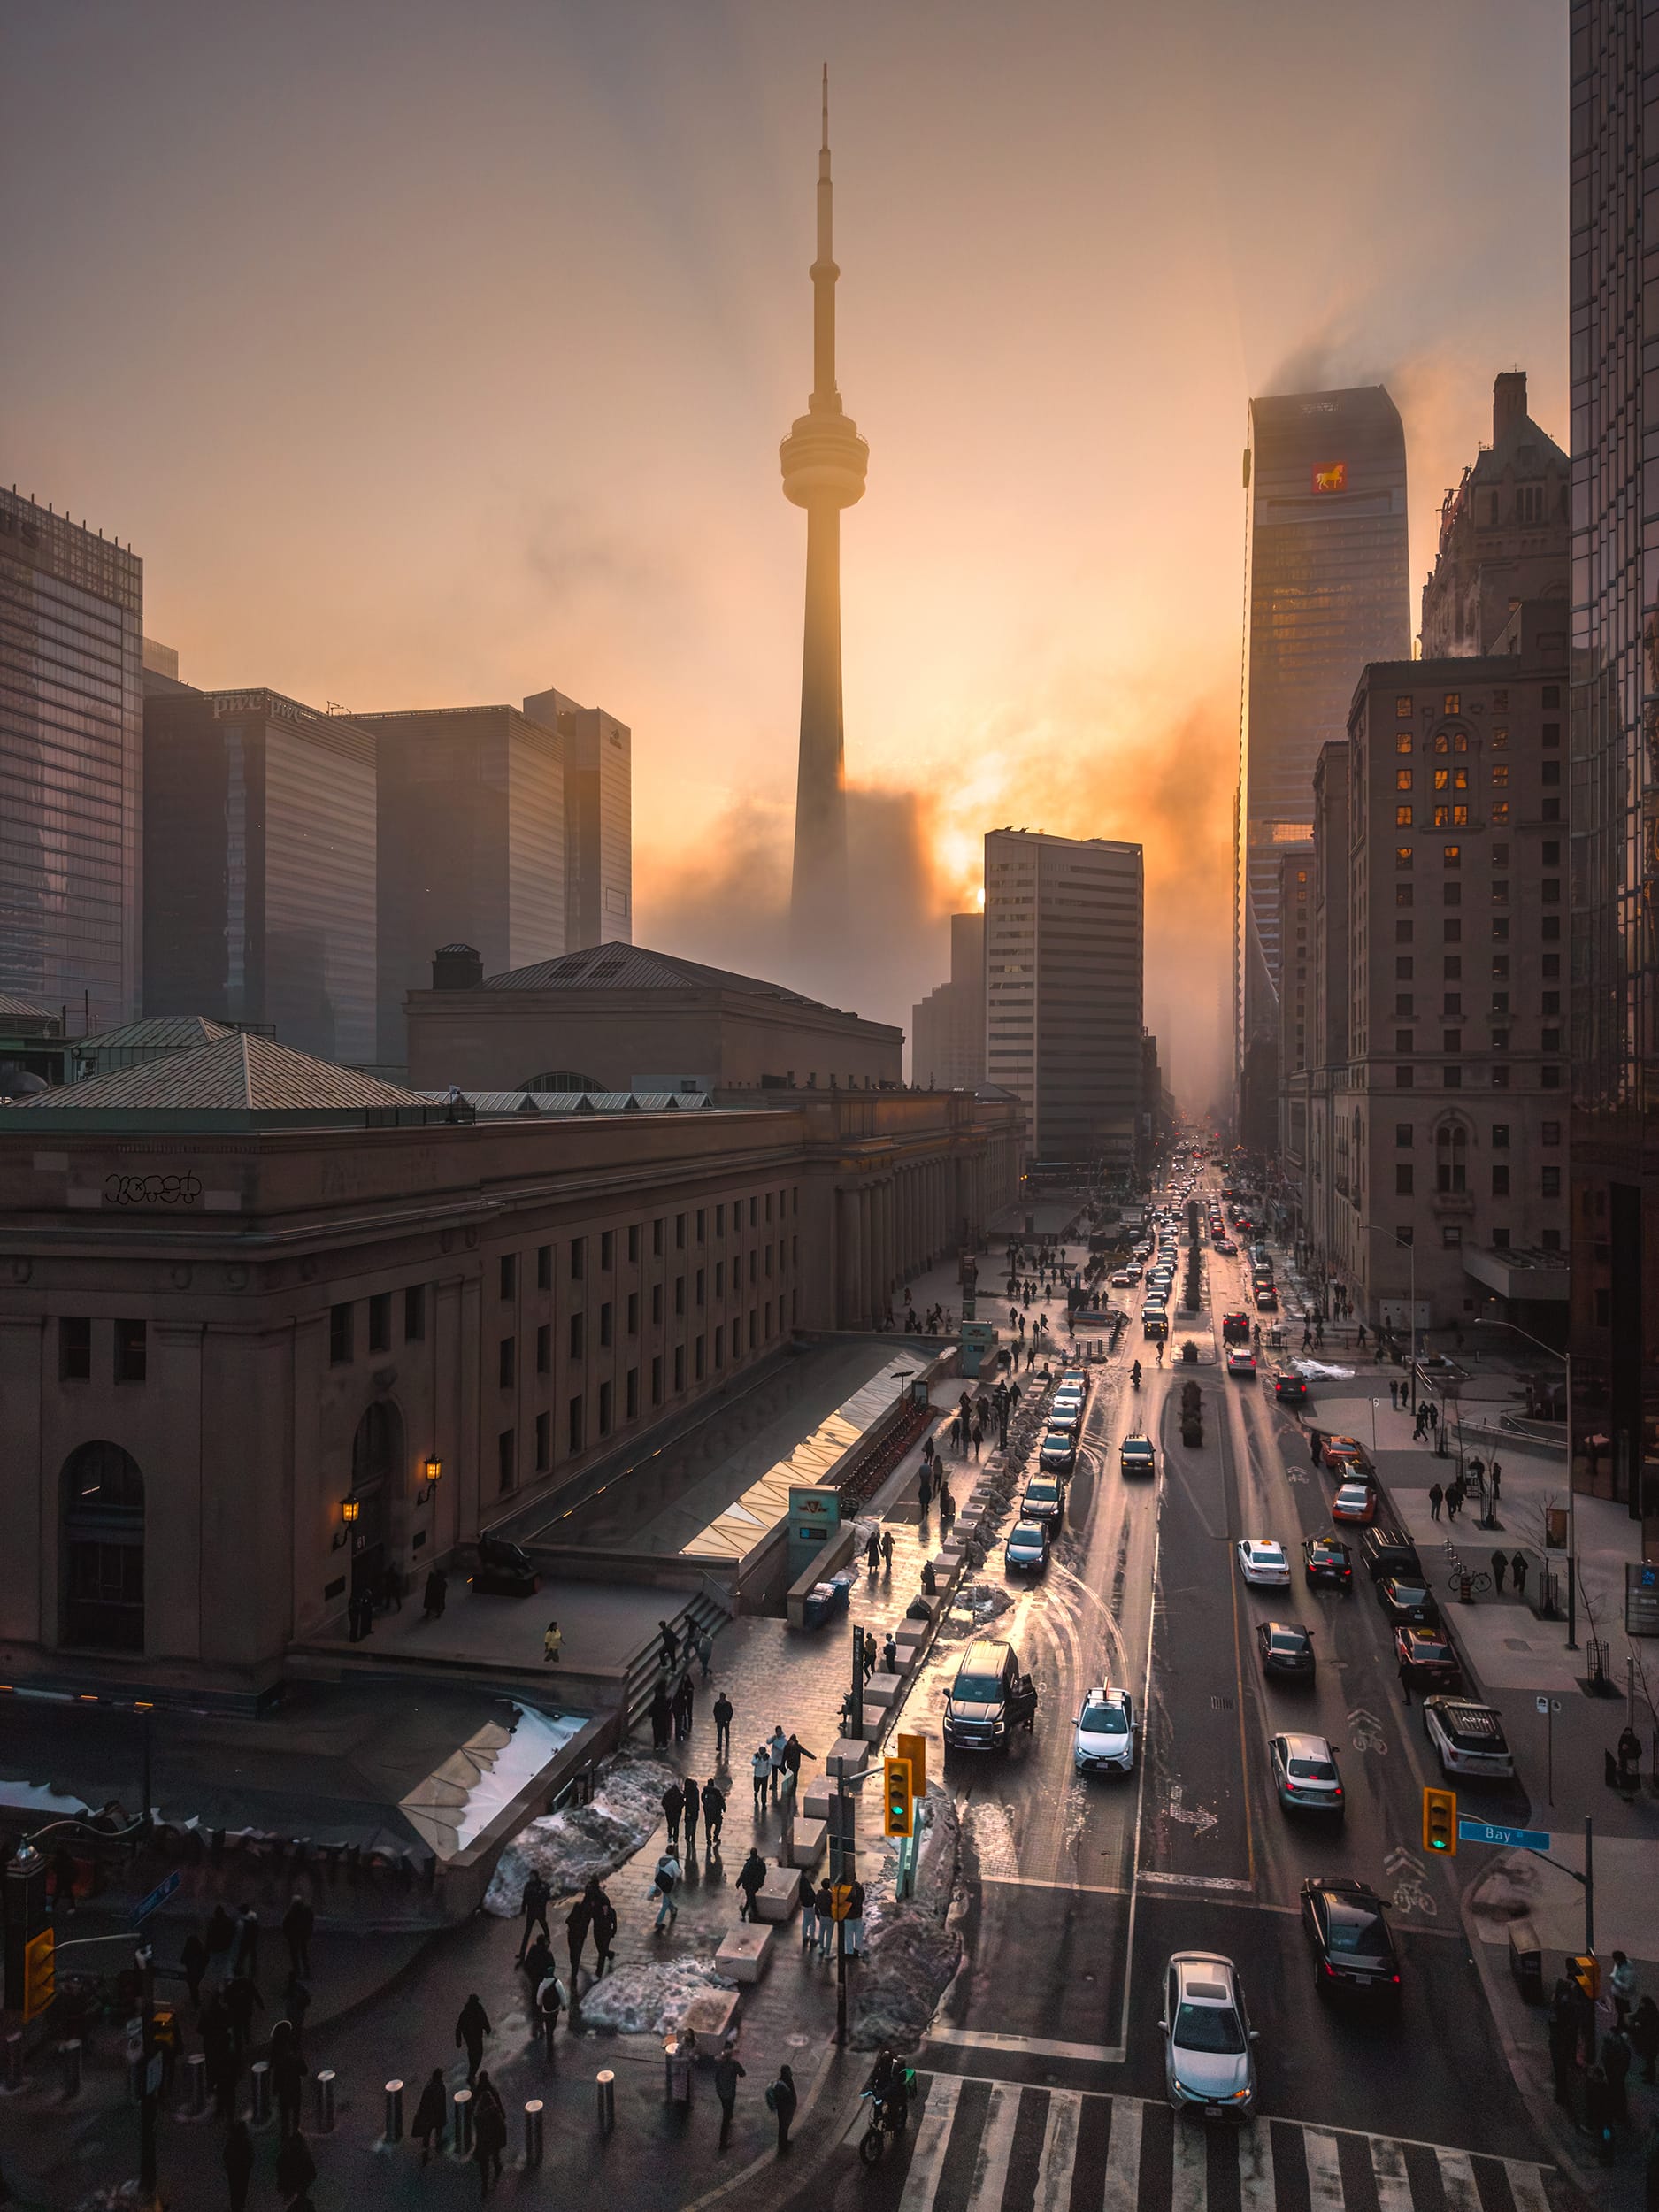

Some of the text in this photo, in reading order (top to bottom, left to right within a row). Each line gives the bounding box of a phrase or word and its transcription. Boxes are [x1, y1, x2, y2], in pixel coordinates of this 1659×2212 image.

[212, 694, 264, 719] pwc
[269, 699, 303, 724] pwc
[1486, 1826, 1511, 1844] Bay
